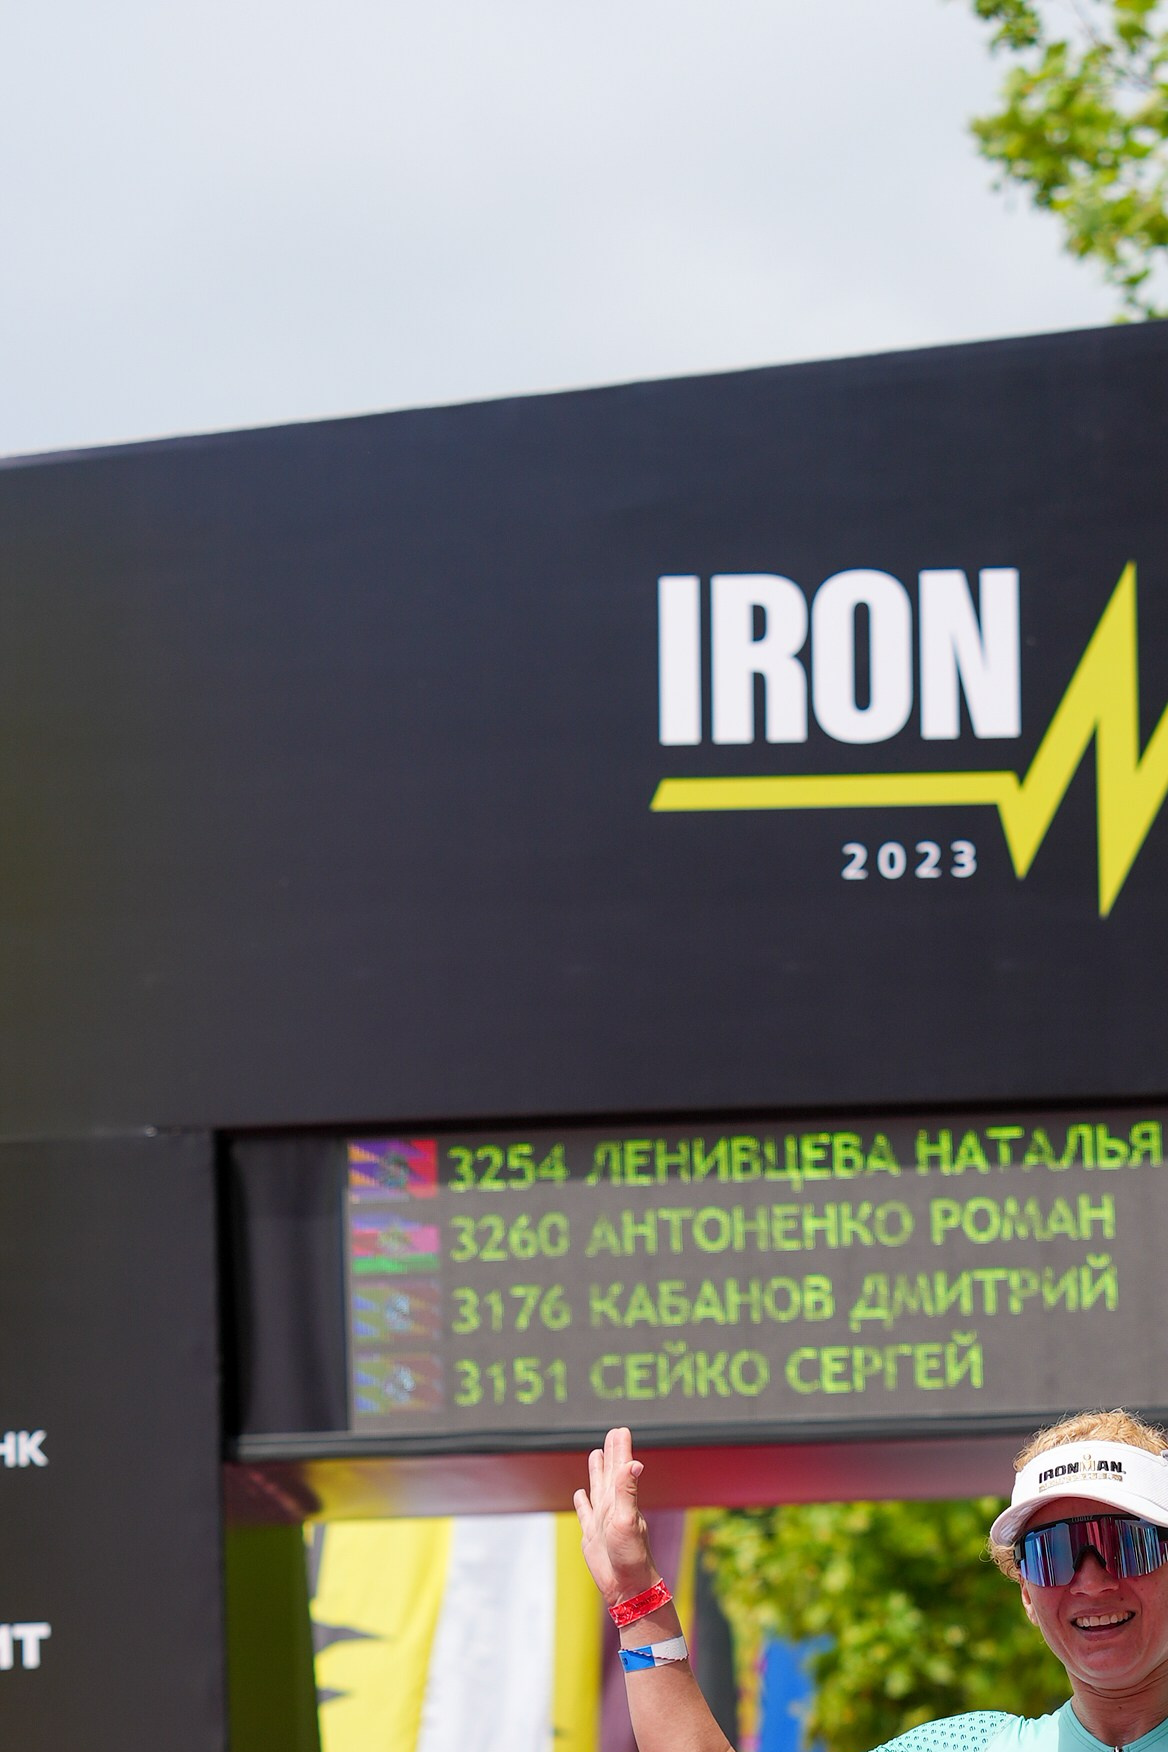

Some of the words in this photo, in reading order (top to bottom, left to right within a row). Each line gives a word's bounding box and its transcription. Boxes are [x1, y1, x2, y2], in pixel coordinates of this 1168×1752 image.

[658, 567, 1020, 746] IRON
[842, 841, 977, 879] 2023
[448, 1142, 569, 1192] 3254
[585, 1130, 902, 1191] ЛЕНИВЦЕВА
[915, 1120, 1163, 1177] НАТАЛЬЯ
[451, 1211, 571, 1262] 3260
[585, 1200, 914, 1258] АНТОНЕНКО
[930, 1194, 1116, 1245] РОМАН
[452, 1284, 572, 1334] 3176
[589, 1274, 836, 1328] КАБАНОВ
[848, 1254, 1119, 1332] ДМИТРИЙ
[454, 1357, 569, 1406] 3151
[589, 1341, 770, 1400] СЕЙКО
[785, 1332, 985, 1393] СЕРГЕЙ
[1038, 1456, 1123, 1484] IRONMAN
